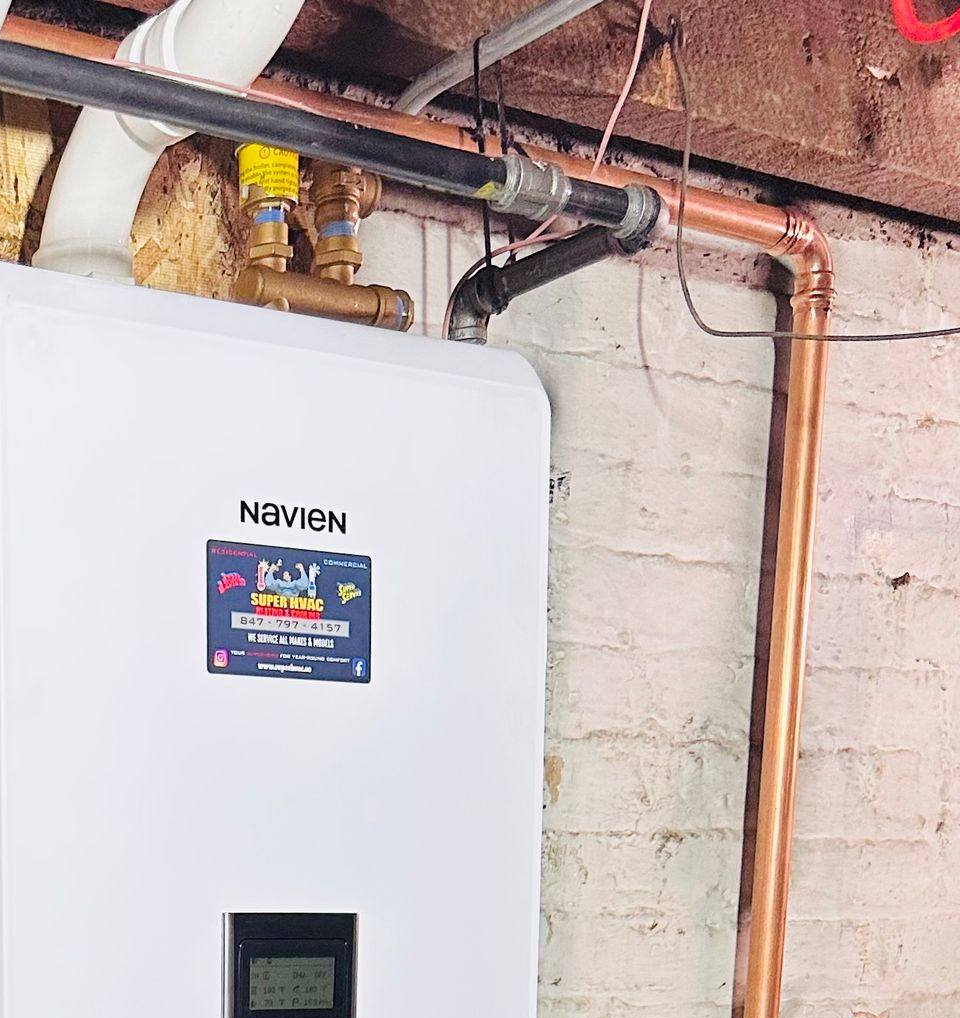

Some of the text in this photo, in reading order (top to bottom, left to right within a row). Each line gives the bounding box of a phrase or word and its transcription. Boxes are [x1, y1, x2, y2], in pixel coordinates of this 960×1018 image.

[323, 559, 368, 569] COMMERCIAL
[250, 592, 324, 612] SUPER HVAC
[240, 616, 264, 626] 847
[276, 619, 299, 629] 797
[310, 622, 342, 633] 4157
[247, 632, 257, 643] WE
[257, 633, 279, 645] SERVICE
[279, 635, 289, 646] ALL
[289, 635, 307, 647] MAKES
[313, 638, 335, 649] MODELS
